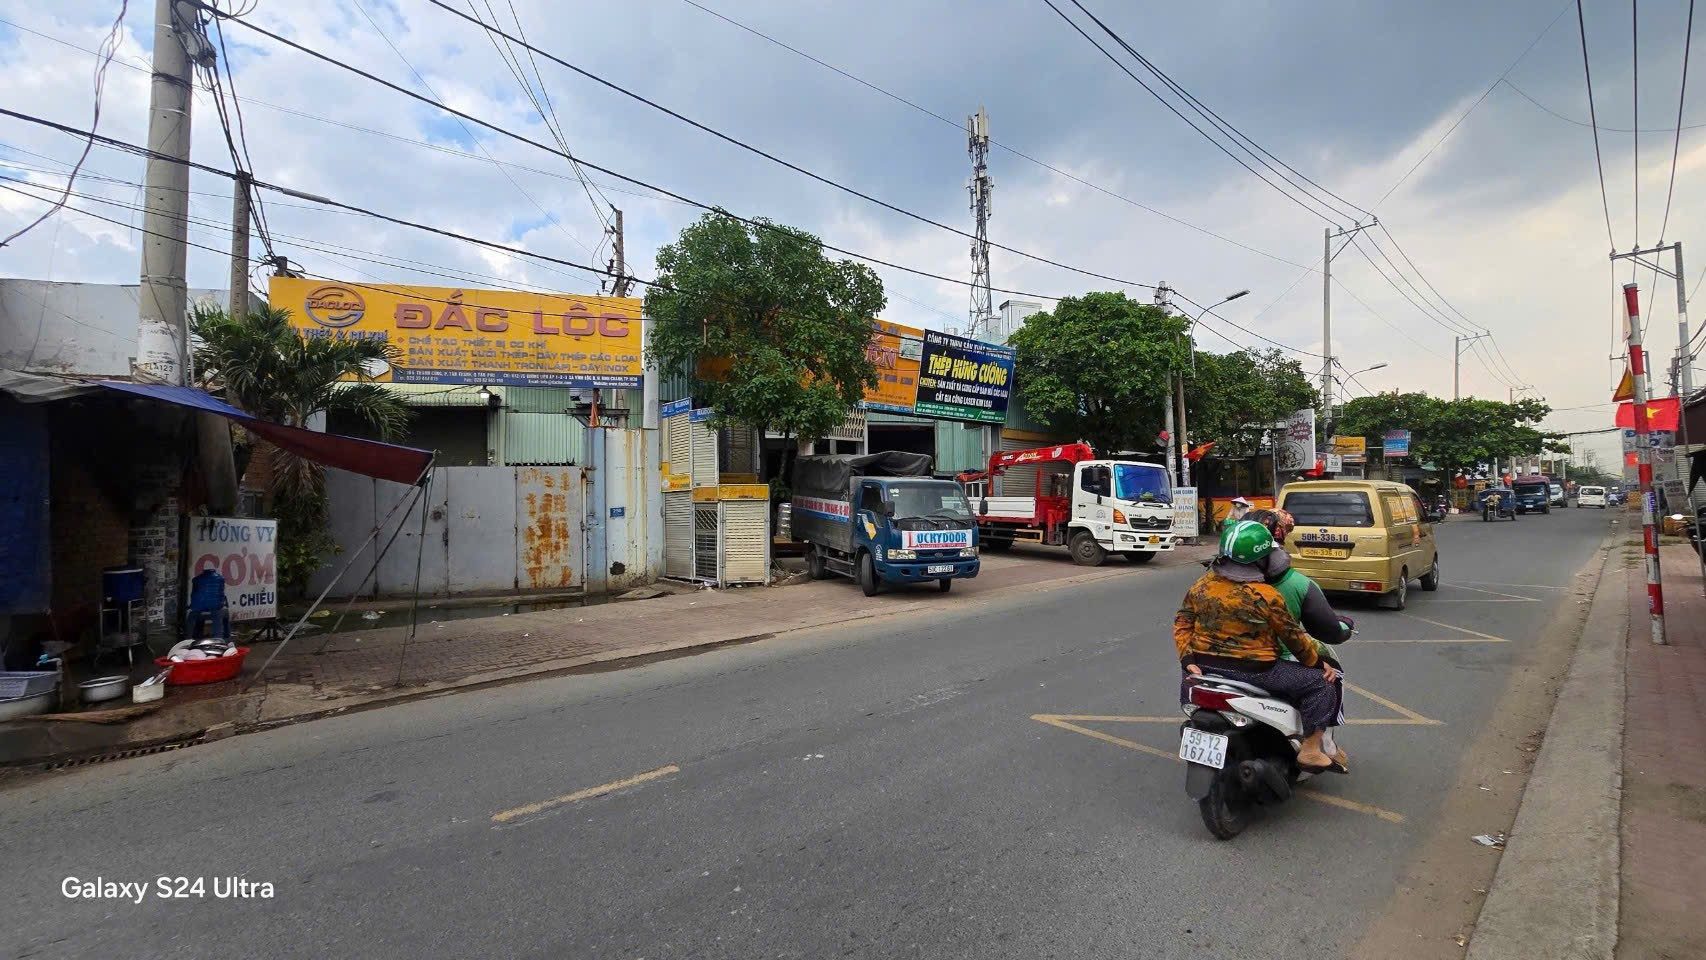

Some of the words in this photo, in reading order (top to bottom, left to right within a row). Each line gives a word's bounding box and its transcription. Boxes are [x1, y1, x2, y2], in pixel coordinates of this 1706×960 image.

[394, 288, 509, 332] ĐẮC
[533, 302, 630, 341] LỘC
[408, 346, 433, 356] SẢN
[437, 346, 468, 357] XUẤT
[560, 351, 587, 362] THÉP
[437, 357, 468, 368] XUẤT
[472, 360, 510, 369] THANH
[928, 350, 952, 377] THÉP
[197, 520, 251, 543] TƯỜNG
[255, 526, 275, 543] VY
[907, 532, 967, 548] LUCKYDOOR
[1301, 533, 1349, 543] 50H-336.10
[1252, 540, 1271, 553] Grab
[194, 547, 276, 587] CƠM
[239, 587, 275, 607] CHIỀU
[1189, 731, 1221, 751] 59-Y2
[1183, 745, 1223, 766] 167.49
